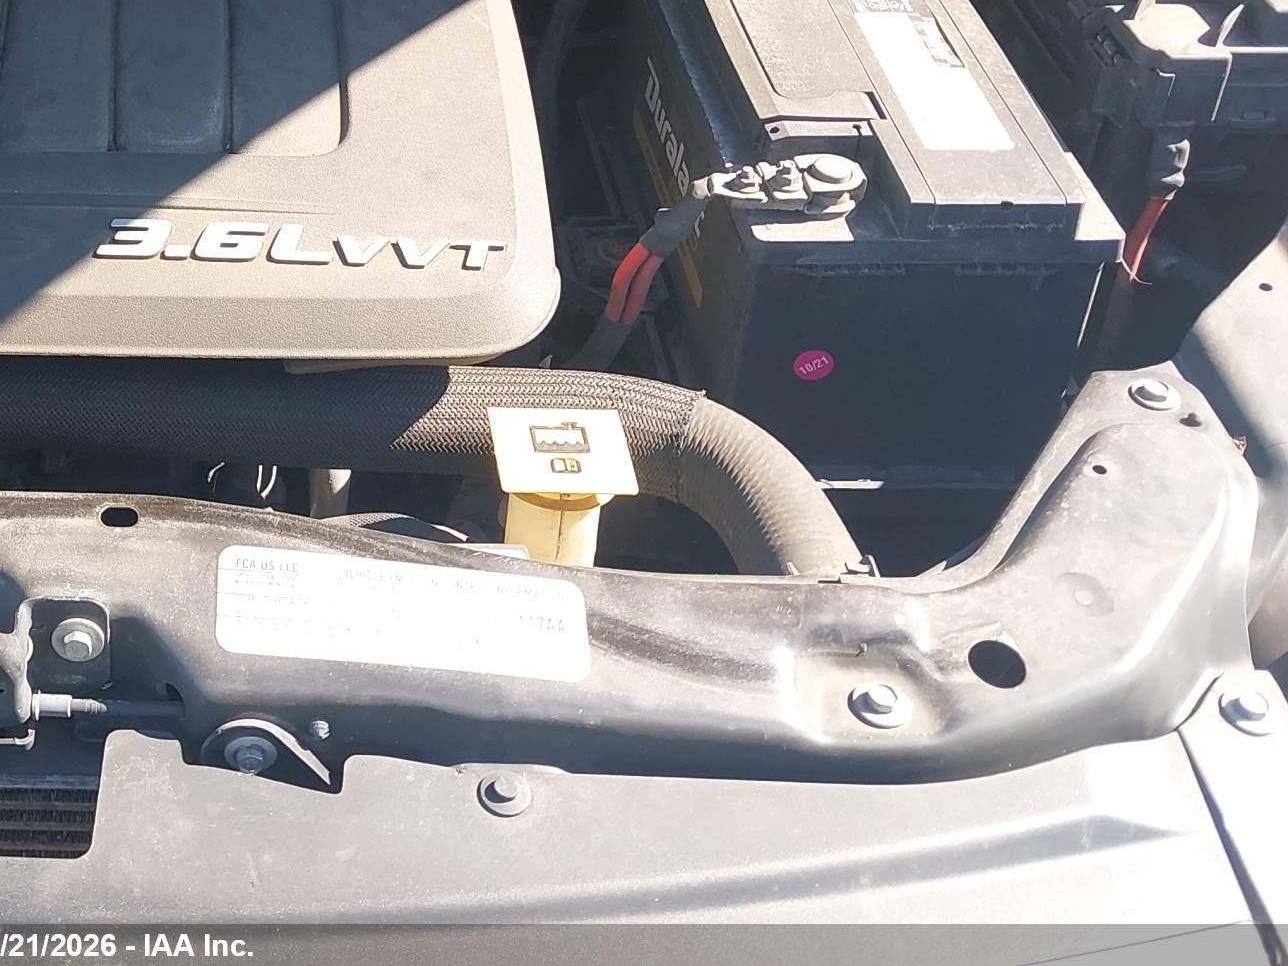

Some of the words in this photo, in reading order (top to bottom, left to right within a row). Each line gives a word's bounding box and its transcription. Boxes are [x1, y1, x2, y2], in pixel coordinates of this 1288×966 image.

[798, 354, 829, 375] 10/21
[235, 557, 256, 570] FCA
[260, 560, 275, 571] US
